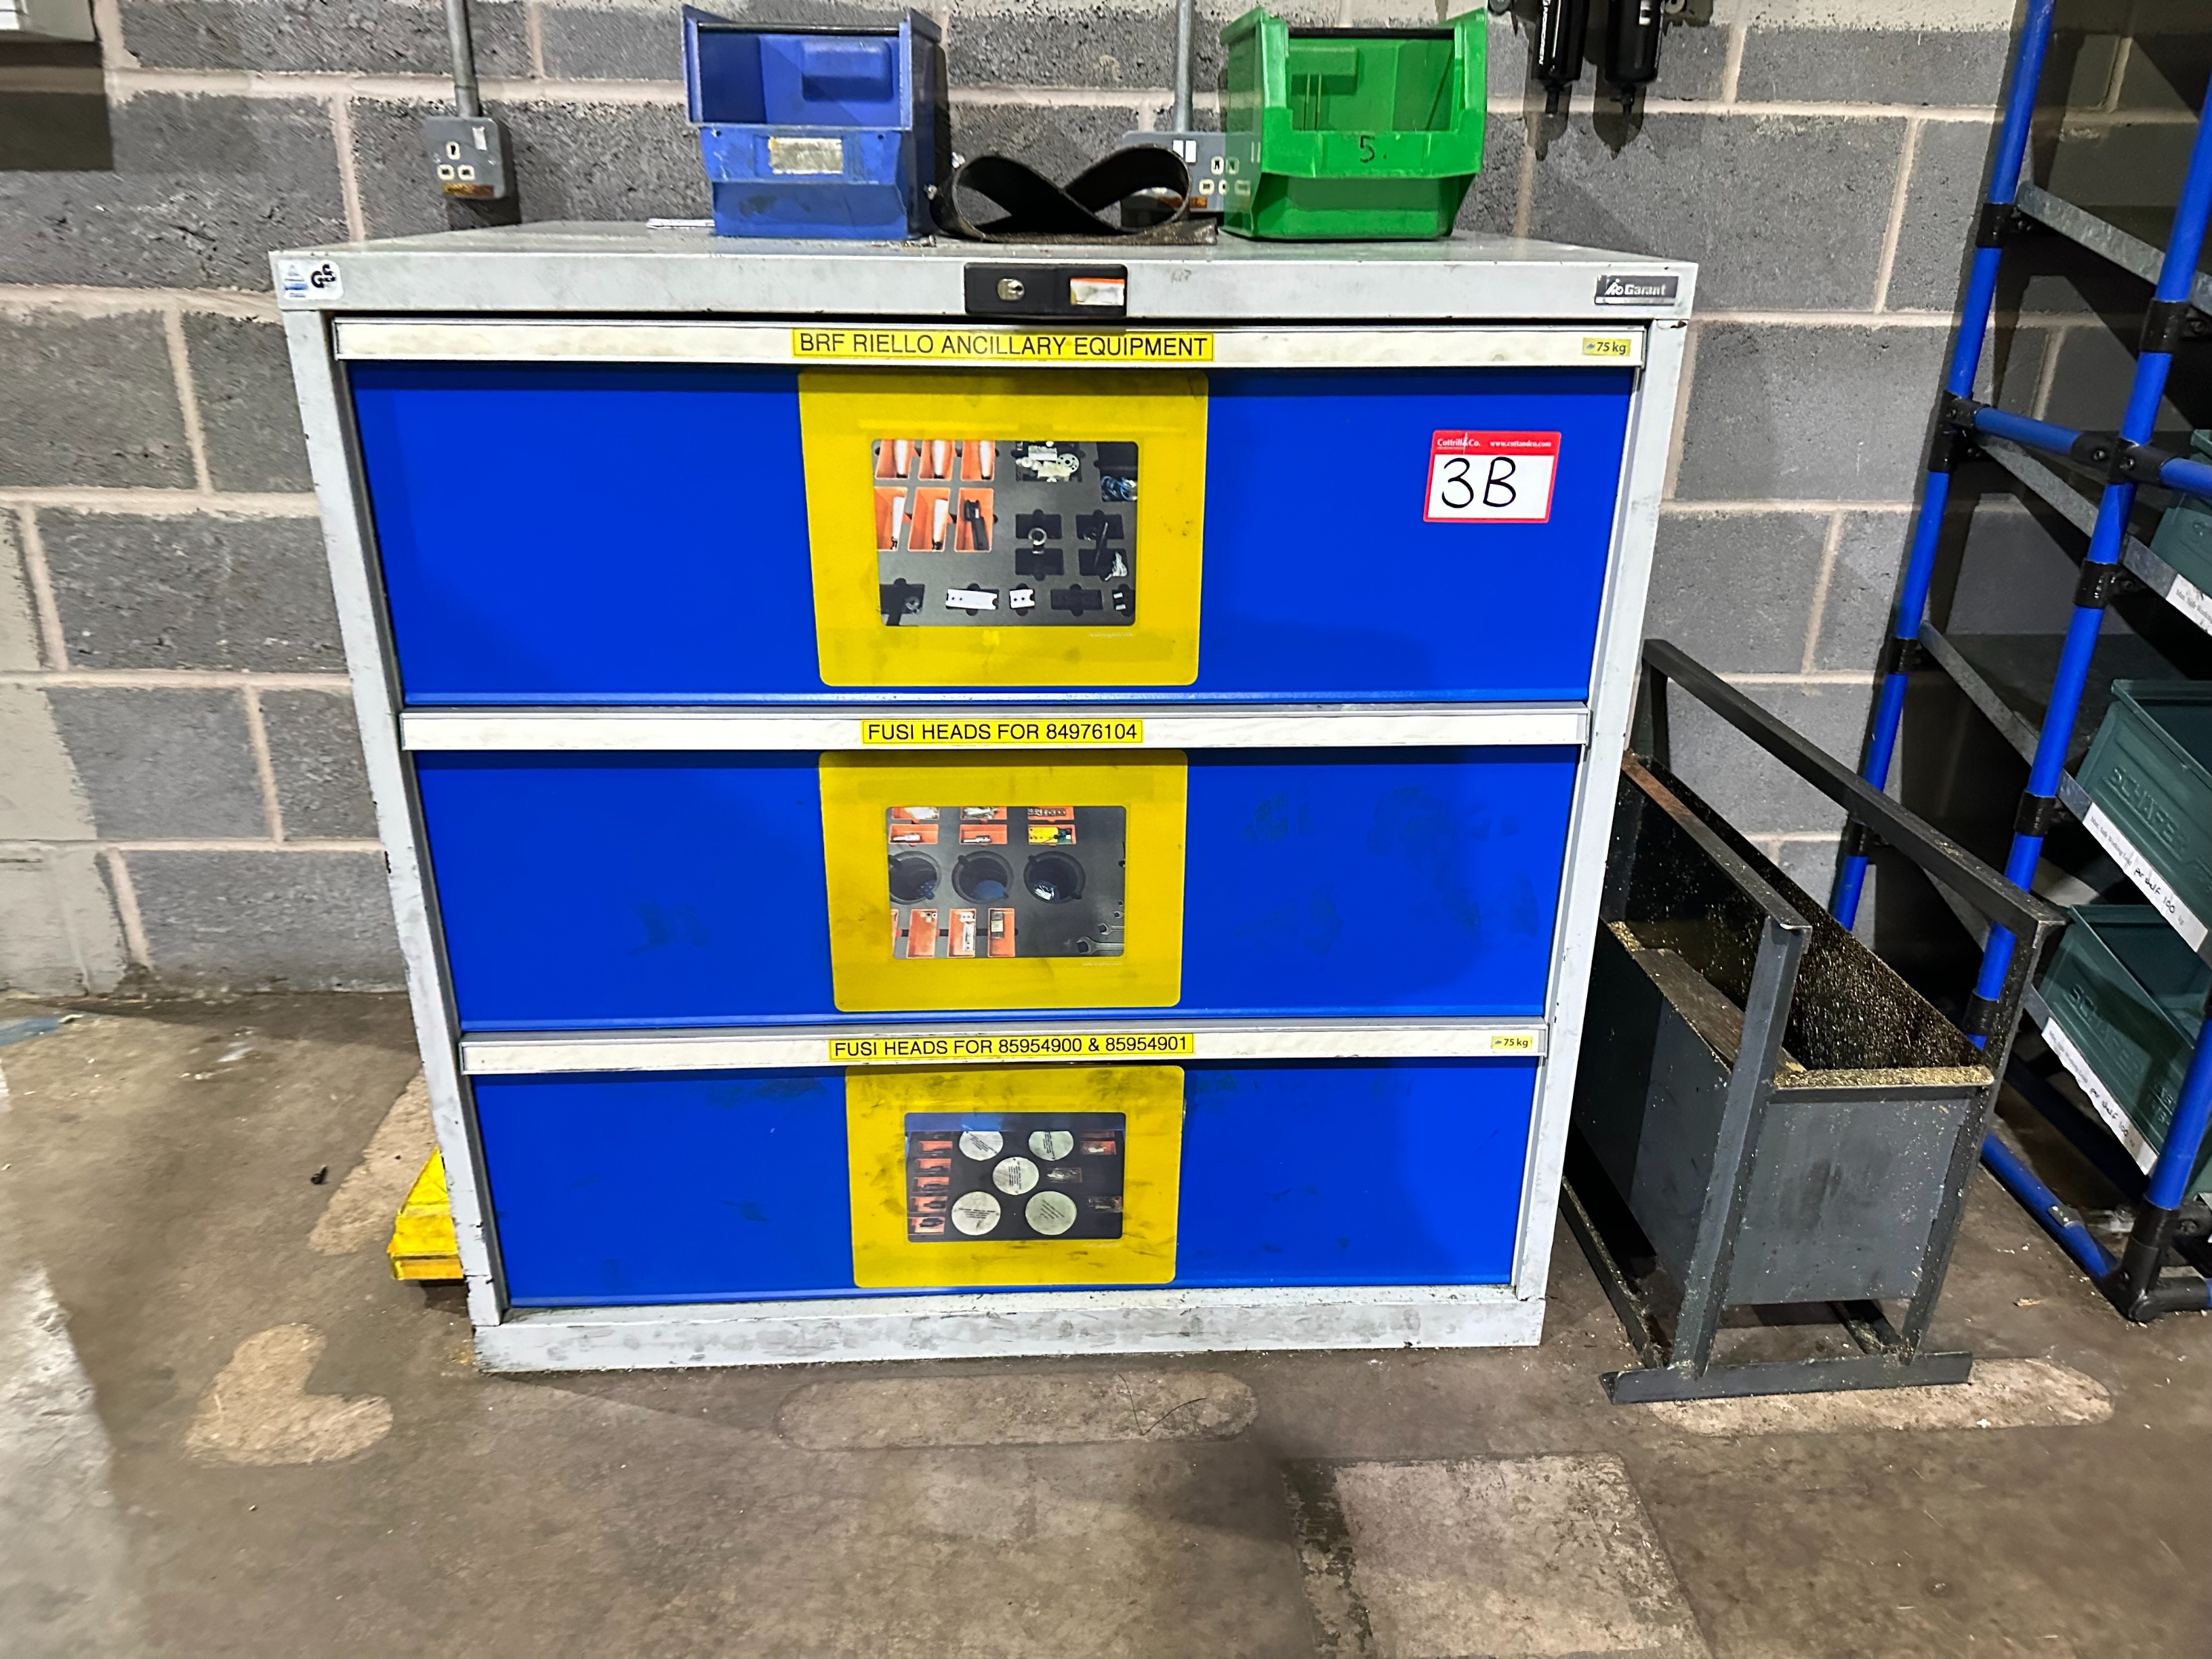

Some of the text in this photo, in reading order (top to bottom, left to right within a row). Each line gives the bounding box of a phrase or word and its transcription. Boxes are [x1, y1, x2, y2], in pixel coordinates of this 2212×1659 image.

[1624, 283, 1666, 296] Garant
[800, 333, 1208, 356] BRF RIELLO ANCILLARY EQUIPMENT
[1596, 341, 1627, 355] 75 kg
[867, 723, 1138, 740] FUSI HEADS FOR 84976104
[835, 1036, 1186, 1057] FUSI HEADS FOR 85954900 & 85954901
[1503, 1038, 1529, 1048] 75 kg
